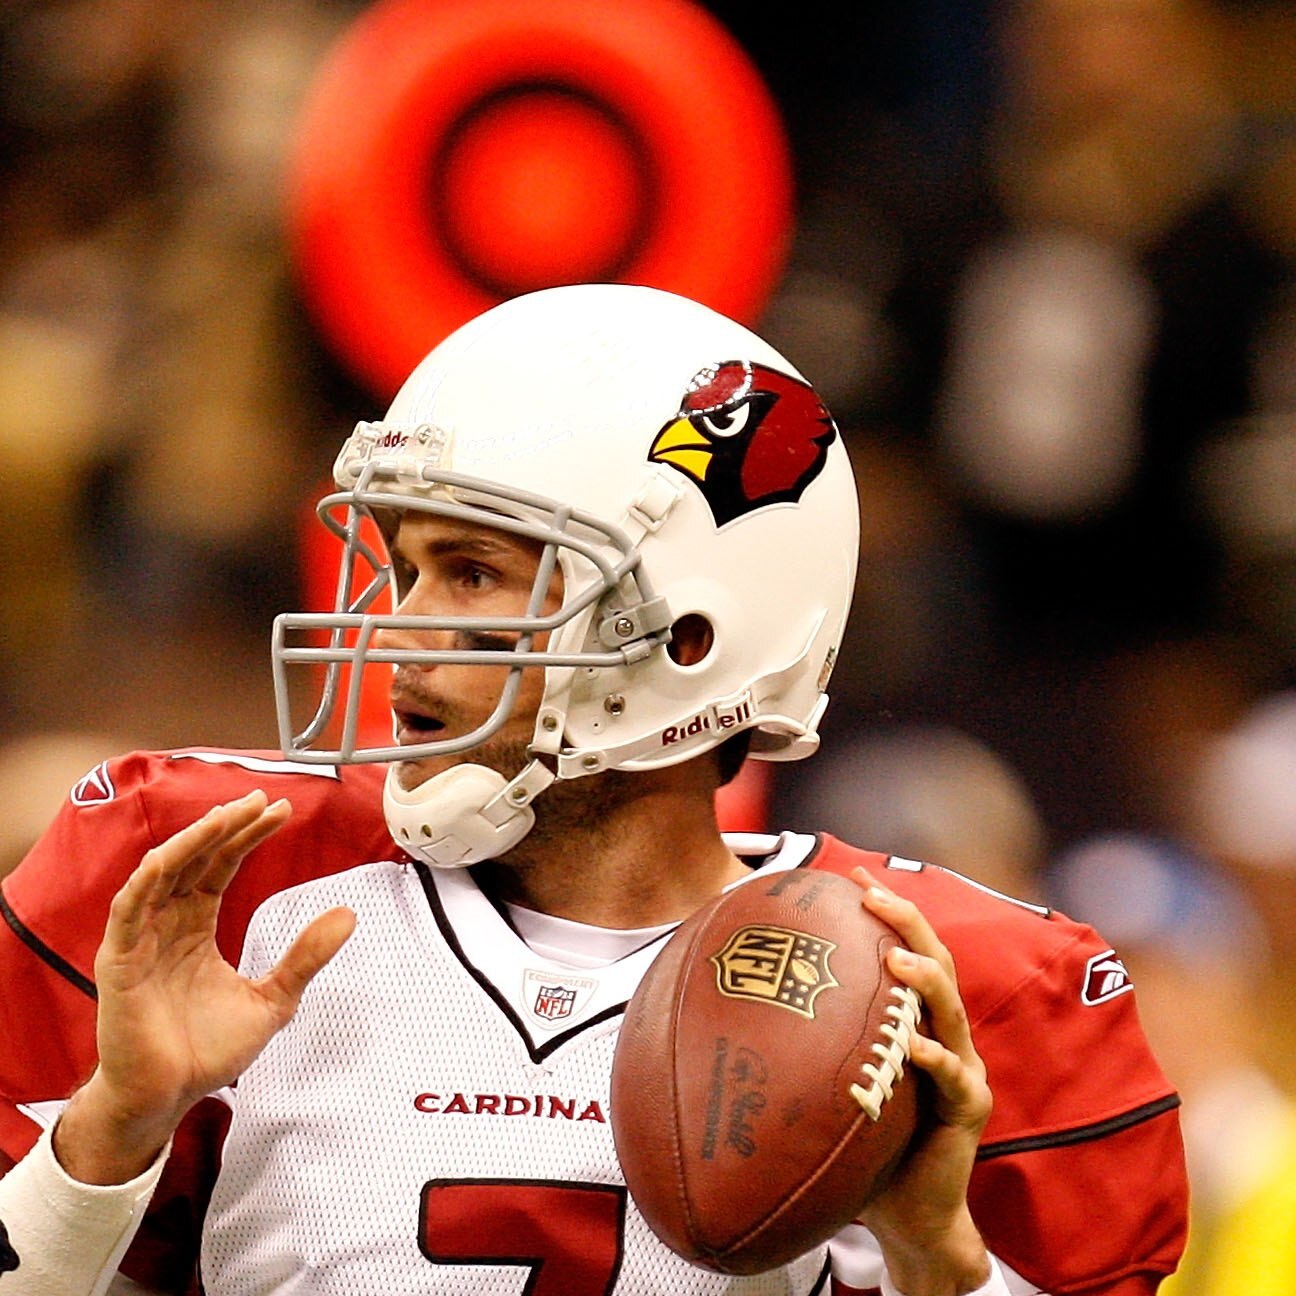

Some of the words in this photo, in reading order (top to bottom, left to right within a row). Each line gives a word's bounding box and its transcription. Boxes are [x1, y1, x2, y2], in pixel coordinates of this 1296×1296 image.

[727, 931, 789, 988] NFL
[539, 998, 570, 1017] NFL
[414, 1092, 607, 1124] CARDINA
